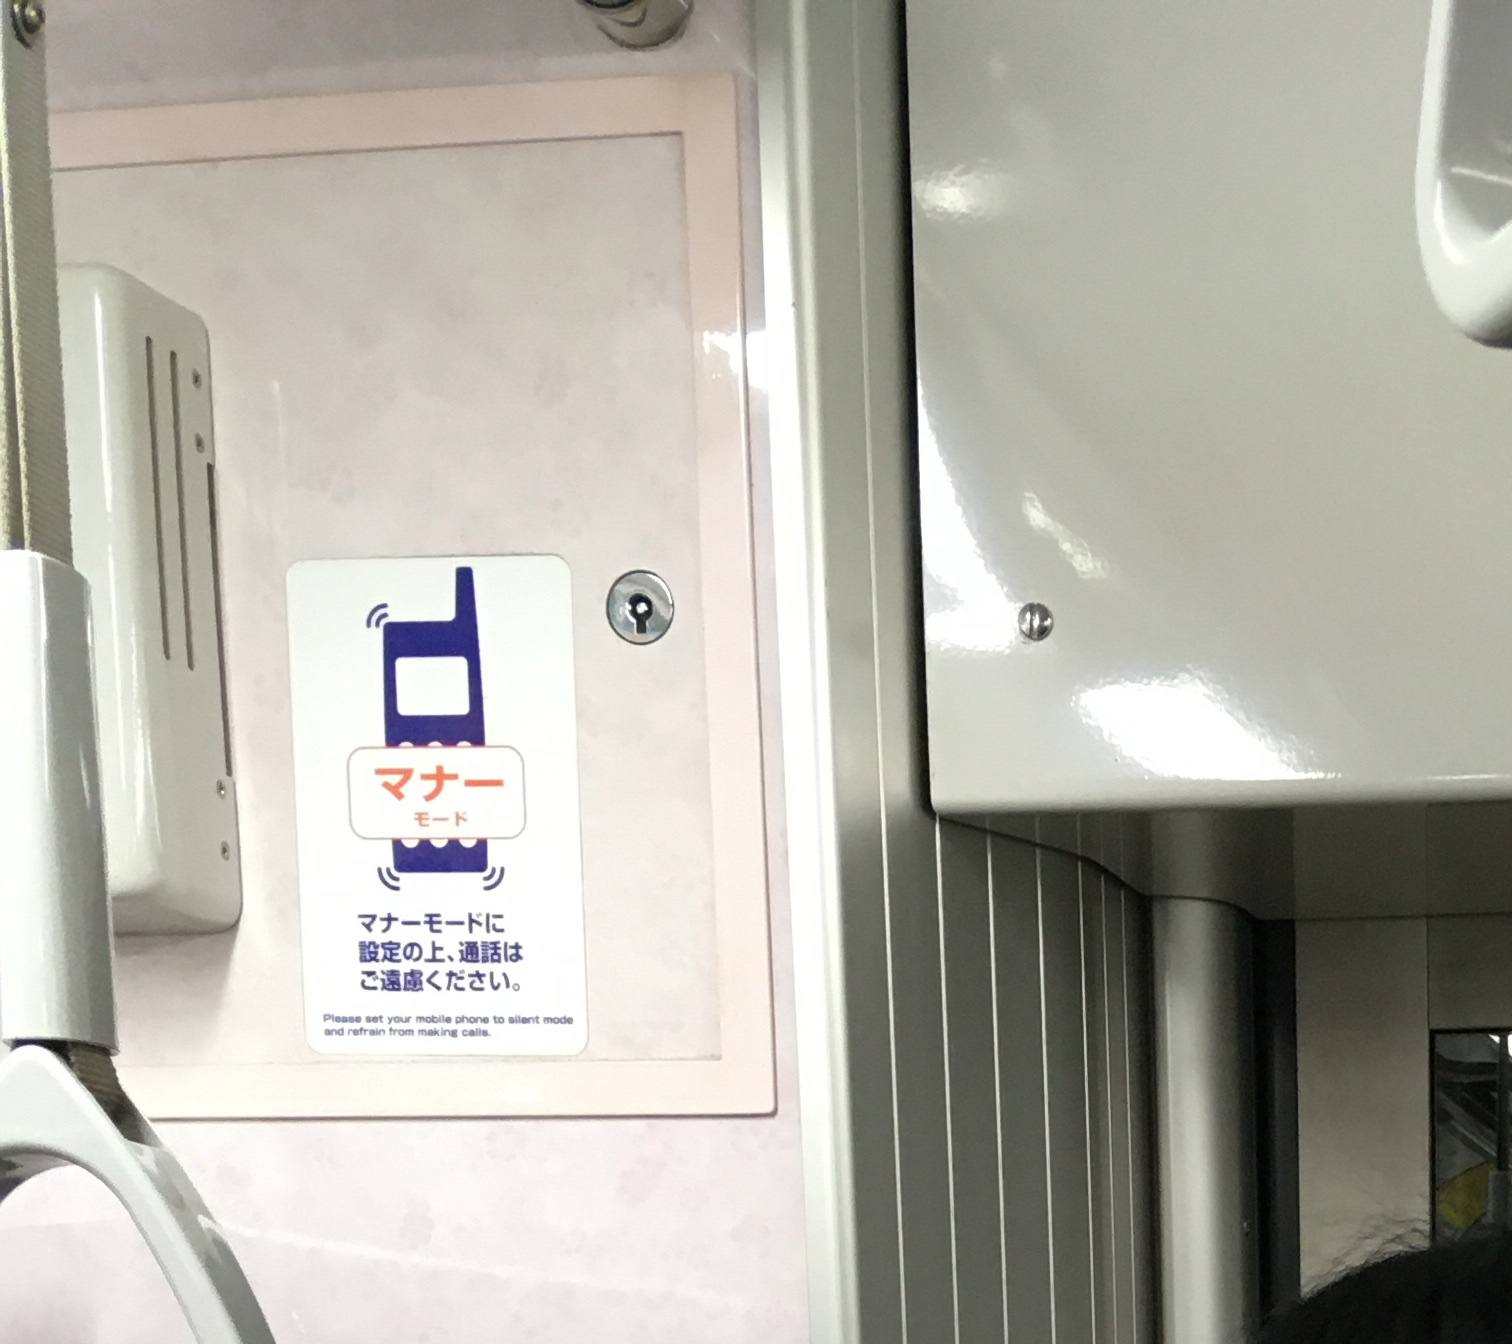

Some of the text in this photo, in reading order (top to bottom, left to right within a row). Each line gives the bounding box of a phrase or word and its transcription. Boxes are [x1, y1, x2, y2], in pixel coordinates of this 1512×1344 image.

[374, 764, 504, 802] マナー
[413, 811, 467, 828] モード
[357, 912, 505, 934] マナーモードに
[358, 940, 523, 964] 設定の上、通話は
[360, 968, 520, 992] ご遠慮ください。
[323, 1013, 574, 1026] Please set your mobile phone to silent mode
[324, 1026, 492, 1039] and refrain from making calls.
